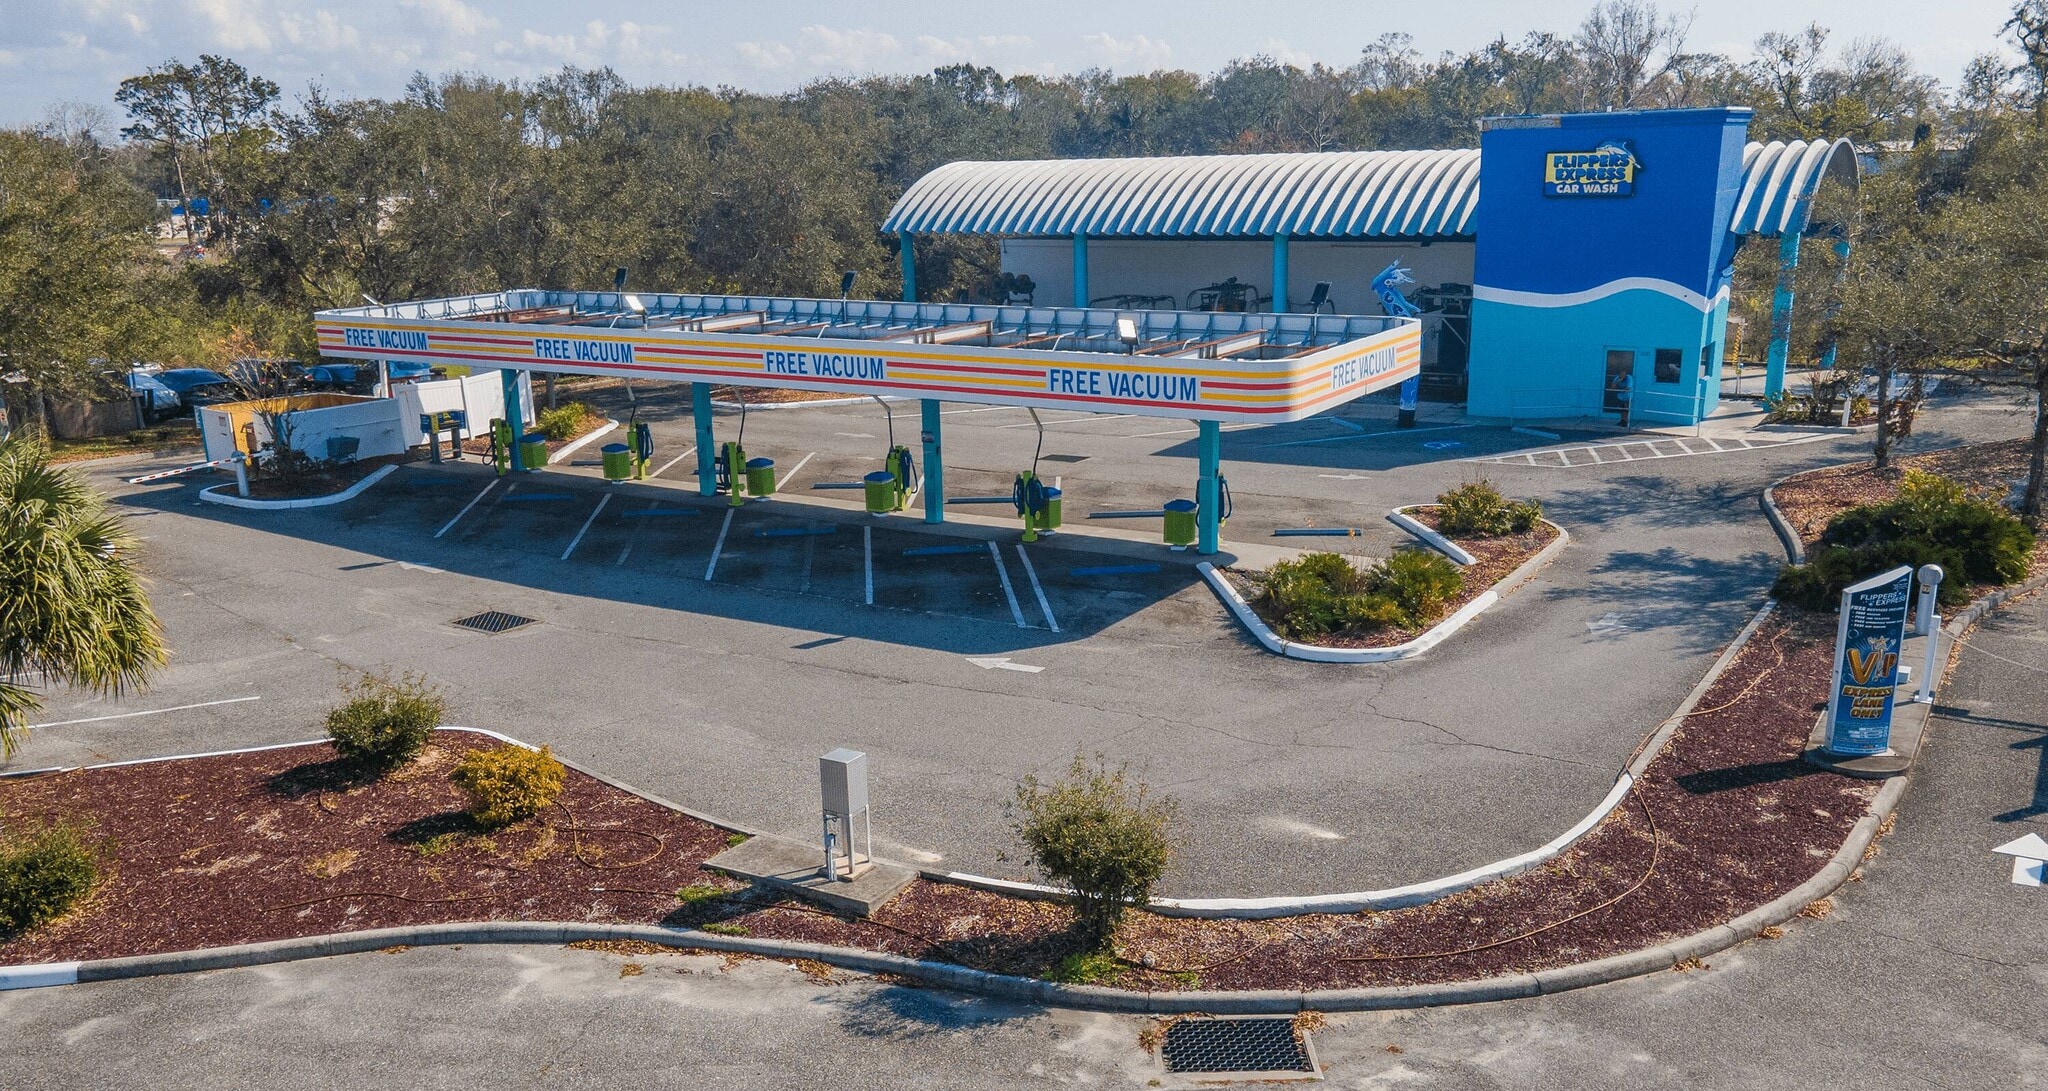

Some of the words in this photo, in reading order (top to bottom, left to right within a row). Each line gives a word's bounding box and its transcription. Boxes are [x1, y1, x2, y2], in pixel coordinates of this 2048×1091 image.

[1554, 154, 1629, 168] FLIPPERS
[1555, 168, 1626, 181] EXPRESS
[1556, 184, 1579, 194] CAR
[1583, 184, 1619, 194] WASH
[346, 328, 376, 347] FREE
[378, 330, 428, 351] VACUUM
[535, 338, 570, 359] FREE
[573, 341, 633, 364] VACUUM
[766, 351, 808, 375] FREE
[812, 354, 884, 380] VACUUM
[1333, 360, 1357, 390] FREE
[1358, 346, 1396, 379] VACUUM
[1050, 368, 1101, 395] FREE
[1107, 372, 1196, 401] VACUUM
[1860, 593, 1897, 601] FLIPPERS
[1875, 594, 1906, 606] EXPRESS
